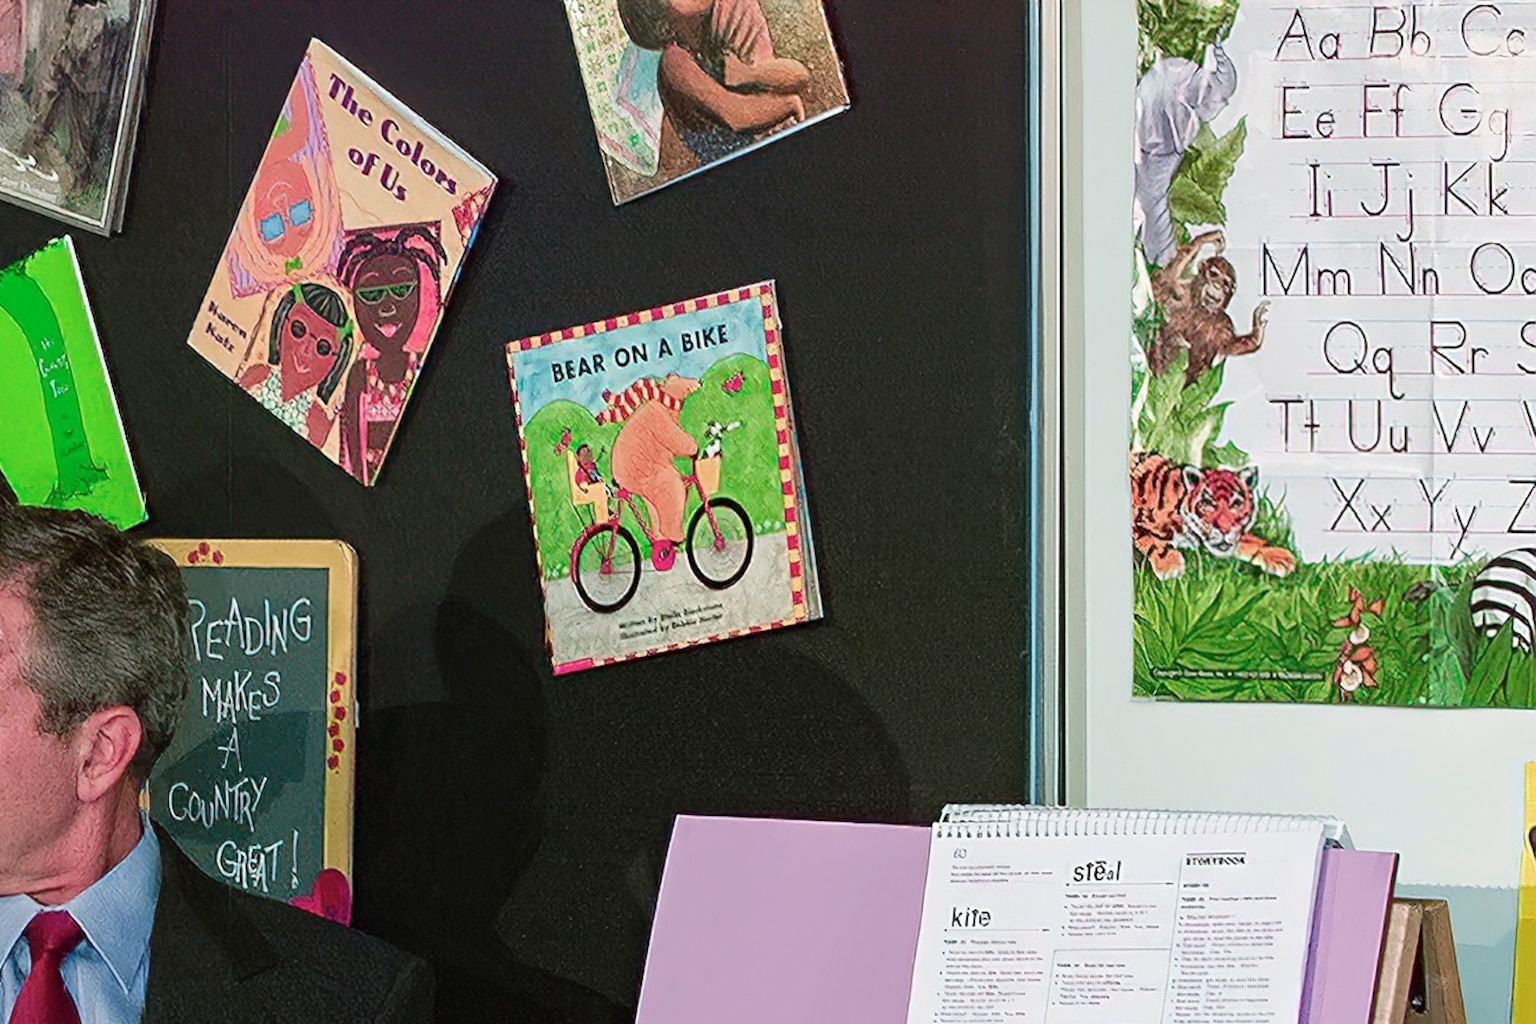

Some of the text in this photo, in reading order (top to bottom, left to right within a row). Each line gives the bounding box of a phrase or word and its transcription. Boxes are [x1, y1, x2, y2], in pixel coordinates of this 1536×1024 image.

[1275, 4, 1525, 60] Aa Bb Cc
[329, 72, 457, 195] The Colors
[1282, 83, 1510, 162] Ee Ff Gg
[348, 148, 407, 201] of Us
[1309, 161, 1509, 242] Ii Jj Kk
[1263, 242, 1351, 295] Mm
[1380, 242, 1439, 295] Nn
[208, 300, 247, 339] Karen
[551, 324, 729, 383] BEAR ON A BIKE
[1323, 321, 1405, 400] Qq
[1430, 321, 1489, 375] Rr
[1269, 399, 1320, 452] Tt
[1348, 399, 1408, 453] Uu
[1432, 400, 1494, 453] Vv
[1331, 478, 1391, 532] Xx
[1419, 479, 1476, 560] Yy
[201, 670, 280, 724] MAKES
[216, 726, 243, 773] A
[951, 906, 991, 928] kite
